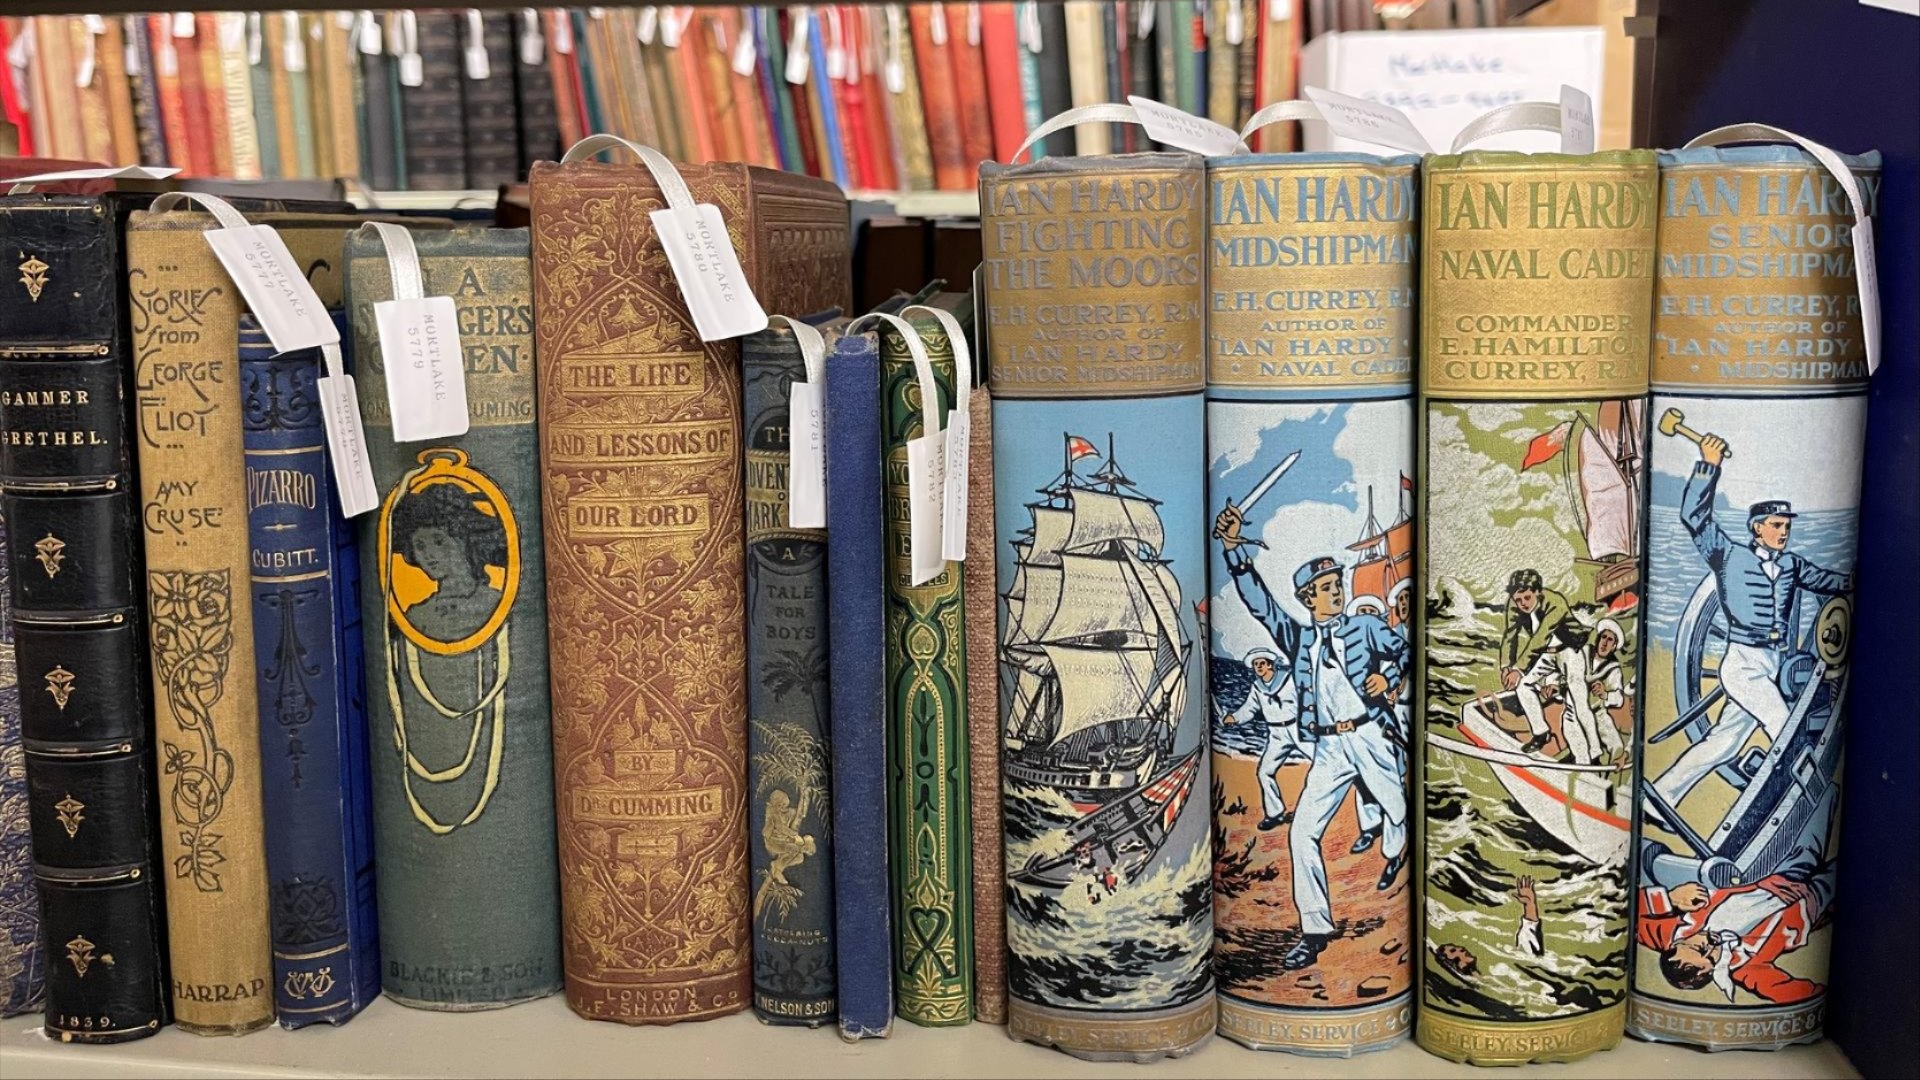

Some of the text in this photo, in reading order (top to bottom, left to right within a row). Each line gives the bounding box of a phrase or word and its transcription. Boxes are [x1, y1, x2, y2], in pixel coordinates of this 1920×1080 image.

[986, 178, 1200, 217] IAN HARDY
[1211, 174, 1415, 225] IAN HARDY
[1436, 180, 1654, 231] IAN HARDY
[1664, 175, 1742, 217] IAN
[996, 216, 1191, 253] FIGHTING
[1708, 223, 1851, 249] SENIOR
[695, 219, 736, 304] MORTLAKE
[989, 253, 1200, 291] THE MOORS
[1438, 249, 1550, 280] NAVAL
[253, 240, 308, 318] MORTLAKE
[456, 266, 486, 297] A
[1034, 327, 1166, 342] AUTHOR OF
[1260, 317, 1388, 333] AUTHOR OF
[1455, 314, 1633, 333] COMMANDER
[1714, 321, 1848, 335] AUTHOR OF
[138, 324, 200, 352] from
[407, 327, 425, 370] 5779
[1288, 337, 1394, 357] HARDY
[1745, 338, 1851, 357] HARDY
[423, 313, 447, 402] MORTLAKE
[1075, 342, 1184, 362] HARDY
[136, 347, 224, 403] GEORGE
[569, 360, 692, 389] THE LIFE
[992, 364, 1068, 385] SENIOR
[1258, 360, 1342, 378] NAVAL
[1444, 360, 1587, 384] CURREY,
[2, 390, 89, 406] GAMMER
[139, 395, 220, 449] ELIOT
[2, 430, 109, 446] GRETHEL.
[549, 427, 731, 458] AND LESSONS OF
[764, 426, 790, 443] TH
[155, 480, 199, 503] AMY
[246, 465, 317, 516] PIZARRO
[575, 503, 699, 529] OUR LORD
[749, 501, 783, 532] ARK
[252, 548, 319, 569] CUBITT.
[781, 546, 797, 561] A
[766, 584, 816, 600] TALE
[775, 606, 806, 618] FOR
[765, 625, 816, 640] BOYS
[631, 756, 654, 771] BY
[609, 792, 713, 816] CUMMING
[389, 959, 474, 986] BLACKIE
[481, 966, 495, 984] &
[173, 977, 266, 1003] HARRAP
[606, 986, 697, 1001] LONDON
[619, 1002, 678, 1016] SHAW
[688, 1000, 703, 1013] &
[761, 996, 803, 1016] NELSON
[804, 1004, 814, 1015] &
[1300, 1017, 1381, 1041] SERVICE
[1722, 1015, 1802, 1038] SERVICE
